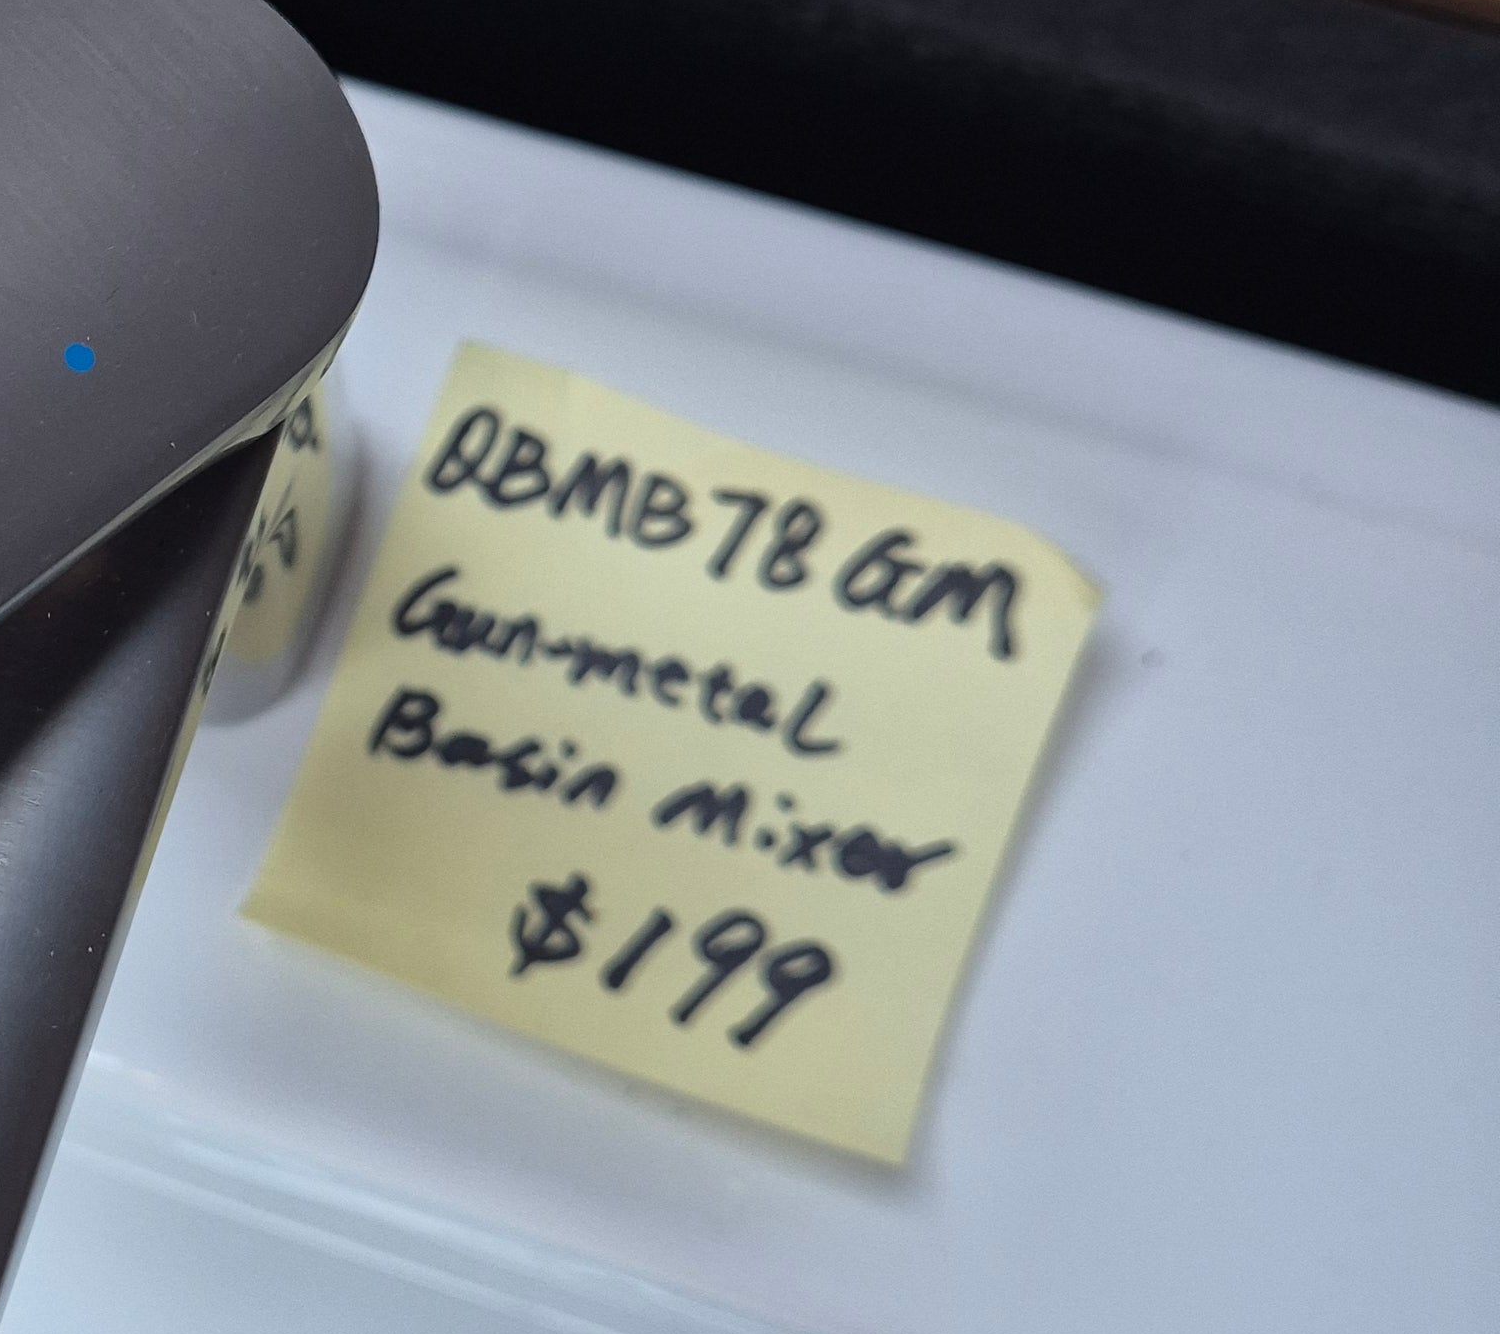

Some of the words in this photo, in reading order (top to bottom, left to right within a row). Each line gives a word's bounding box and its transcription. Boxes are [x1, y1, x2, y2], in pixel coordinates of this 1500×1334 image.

[366, 686, 620, 809] Basin
[650, 783, 957, 894] Mixer
[509, 872, 836, 1050] $199
